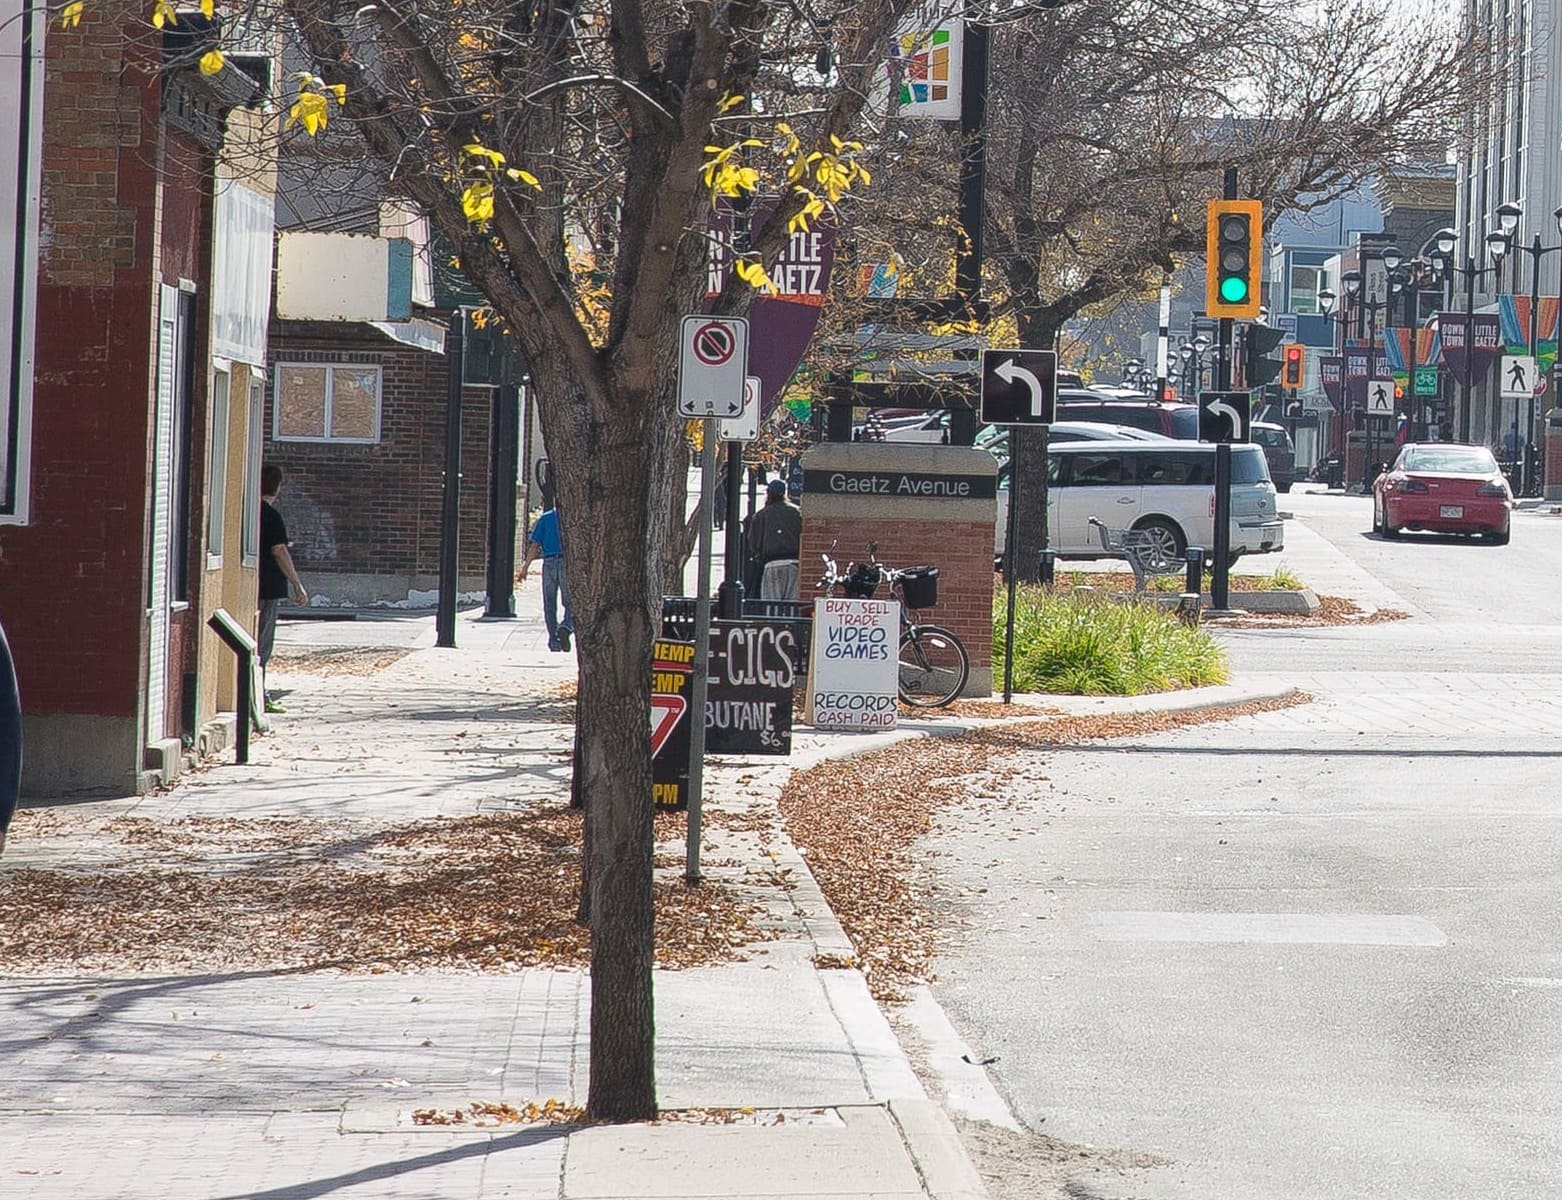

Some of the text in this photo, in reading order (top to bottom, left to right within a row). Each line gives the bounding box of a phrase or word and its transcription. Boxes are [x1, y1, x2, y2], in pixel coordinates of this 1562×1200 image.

[760, 264, 822, 295] AETZ
[1475, 325, 1497, 337] LITTLE
[830, 473, 970, 496] Gaetz Avenue
[826, 600, 890, 615] BUY SELL
[838, 614, 879, 627] TRADE
[828, 626, 887, 643] VIDEO
[825, 643, 888, 660] GAMES
[814, 692, 897, 712] RECORDS
[704, 701, 777, 731] BUTANE
[816, 711, 853, 724] CASH
[652, 783, 678, 804] PM
